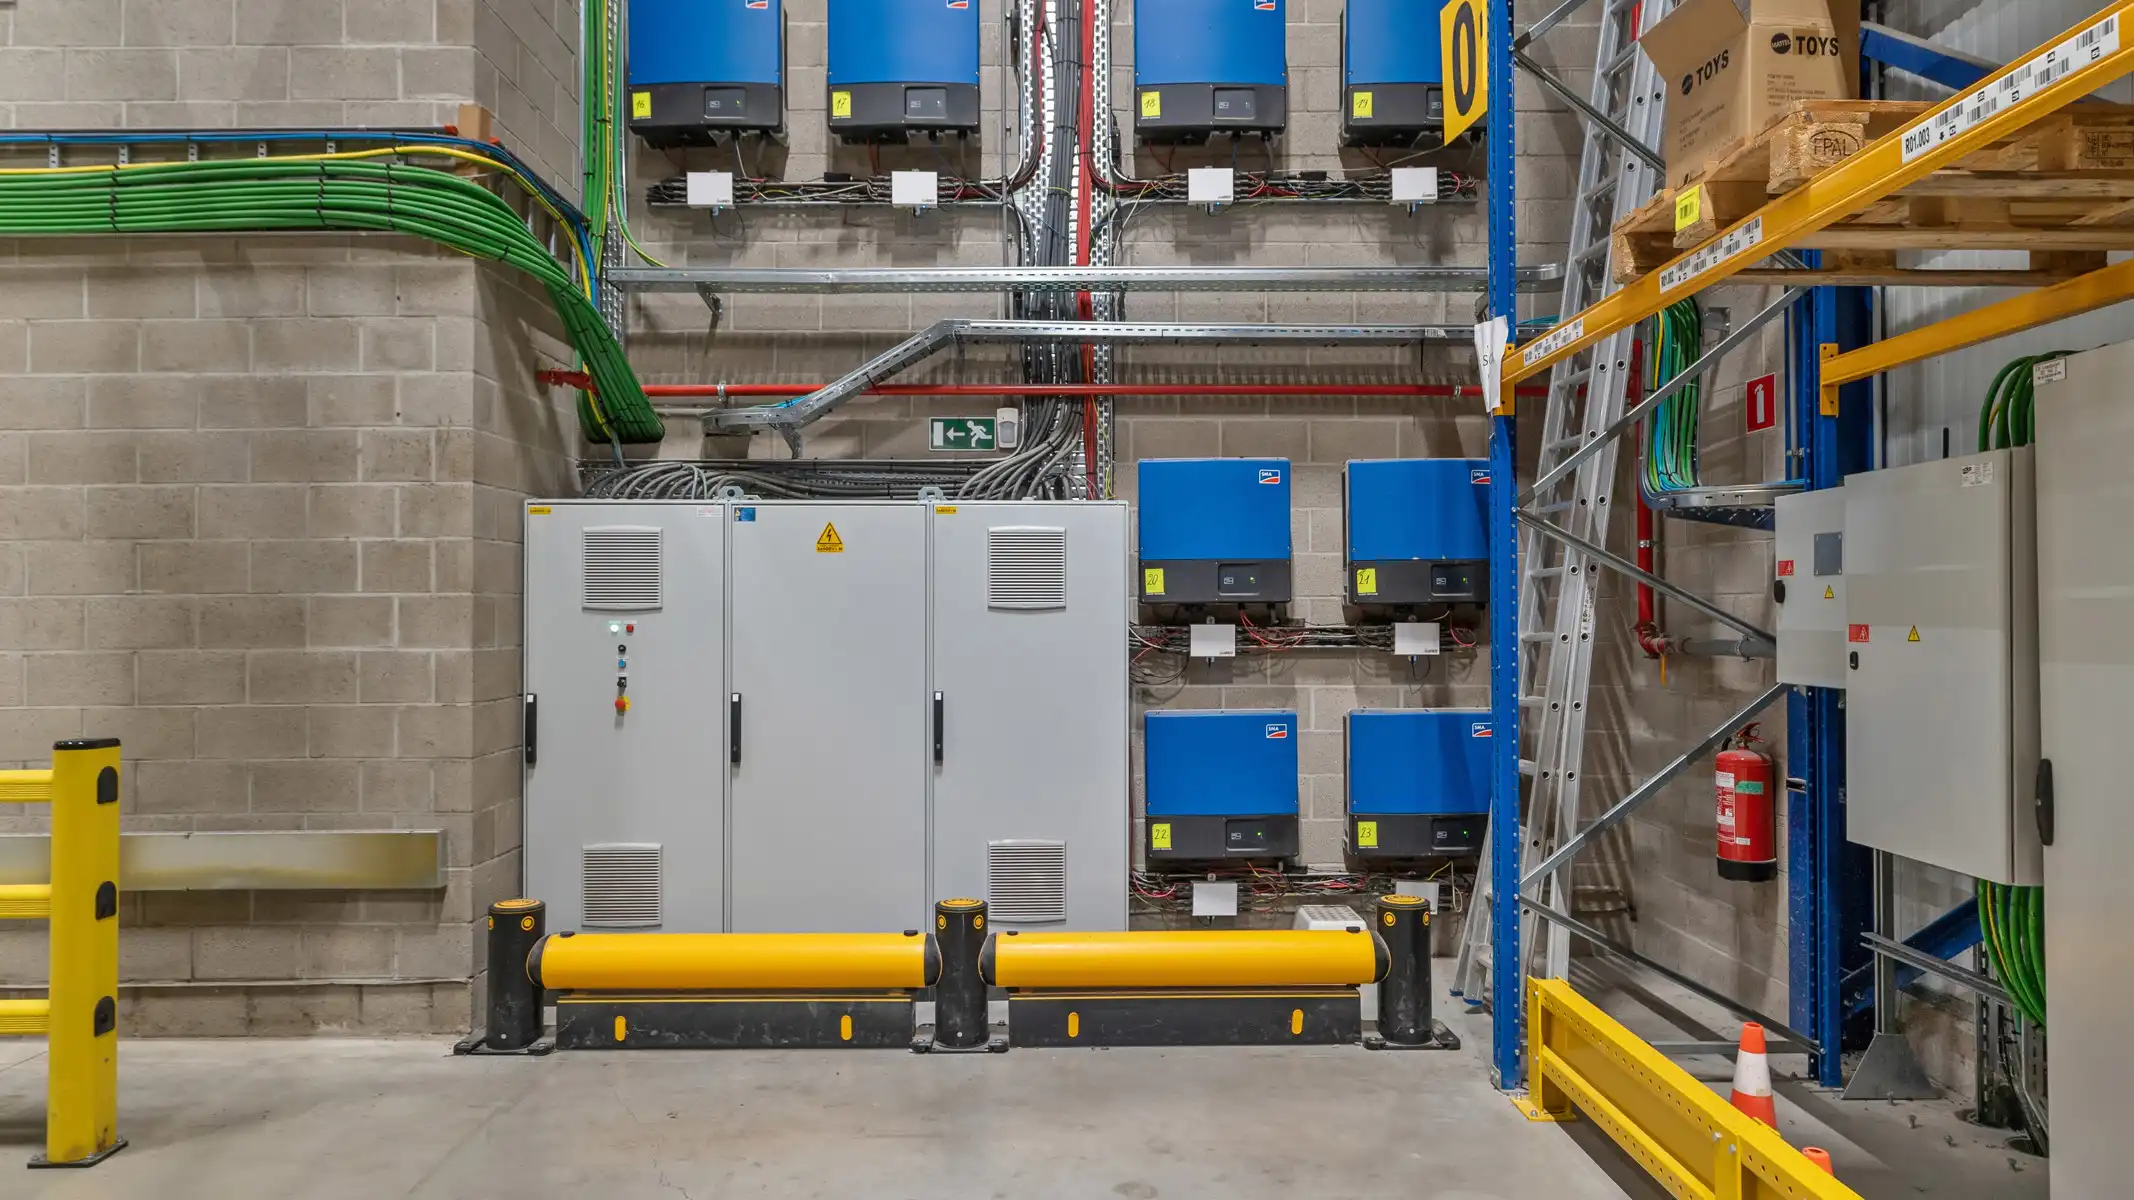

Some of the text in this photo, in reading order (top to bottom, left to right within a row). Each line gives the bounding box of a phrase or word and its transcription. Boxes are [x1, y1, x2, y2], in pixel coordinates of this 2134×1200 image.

[1796, 36, 1839, 57] TOYS
[1452, 1, 1483, 116] 0
[1696, 49, 1729, 86] TOYS
[1905, 126, 1930, 155] R01.003
[1147, 573, 1159, 585] 20
[1358, 573, 1370, 585] 21
[1154, 828, 1167, 840] 22
[1360, 827, 1371, 838] 23
